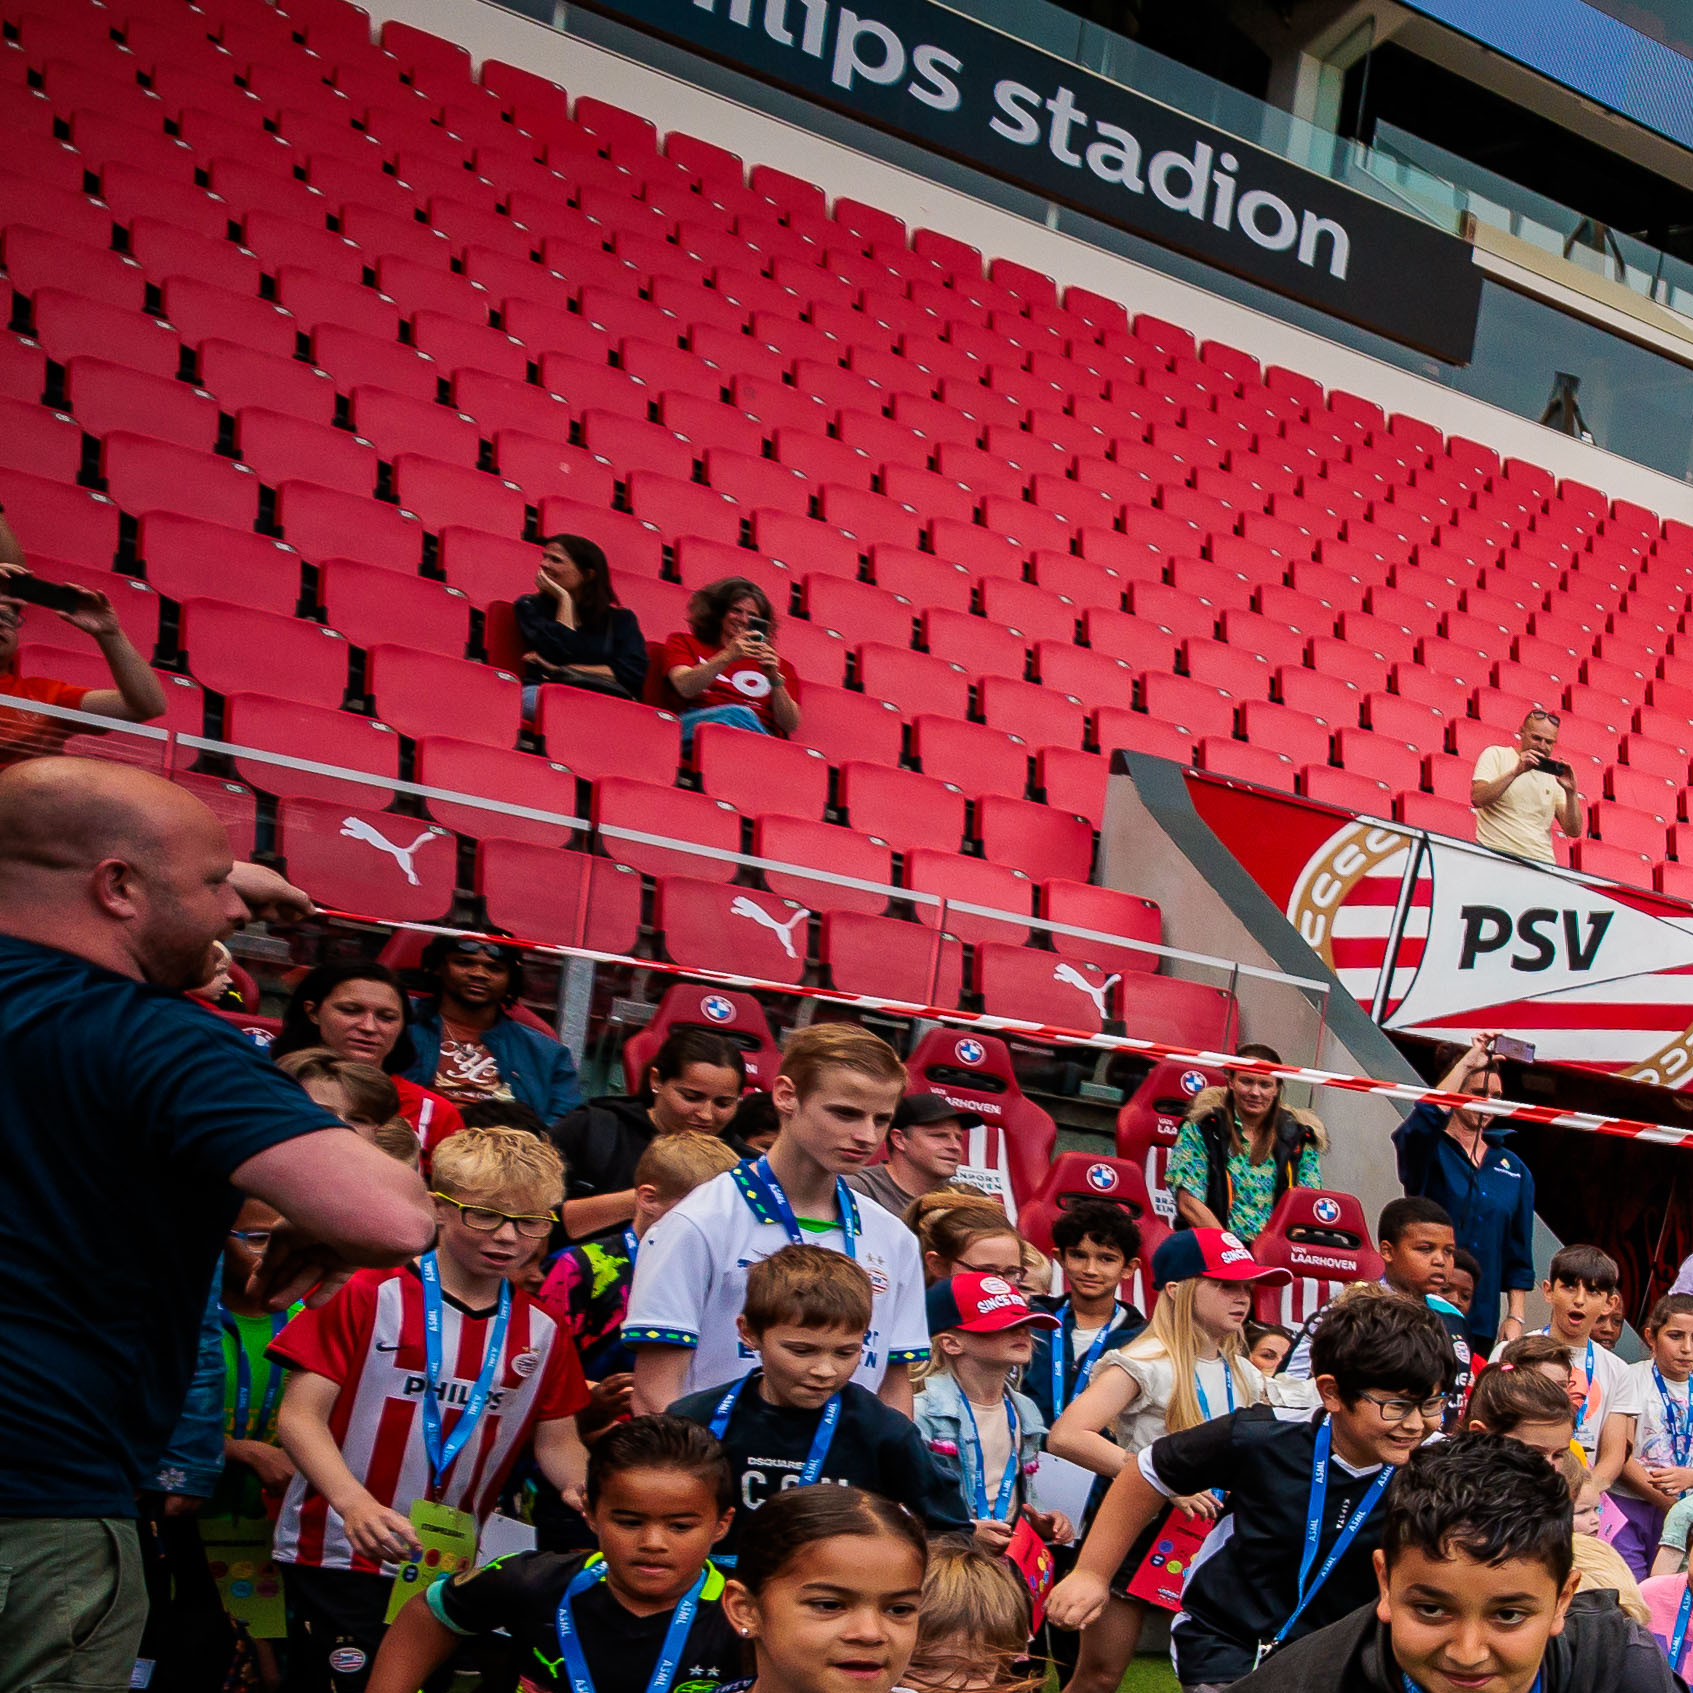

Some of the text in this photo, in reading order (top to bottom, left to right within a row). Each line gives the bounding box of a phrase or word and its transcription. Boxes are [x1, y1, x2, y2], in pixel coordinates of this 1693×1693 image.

[692, 0, 1350, 280] lips stadion
[1458, 904, 1615, 972] PSV
[945, 1096, 1002, 1115] ARHOVEN
[1291, 1246, 1307, 1254] VAN
[1291, 1252, 1357, 1271] LAARHOVEN
[976, 1295, 1007, 1314] SINCE
[747, 1457, 806, 1470] DSQUARE
[804, 1458, 822, 1481] ASML
[1315, 1460, 1325, 1484] ASML
[1378, 1465, 1394, 1487] ASML
[1308, 1518, 1319, 1543] ASML
[1349, 1510, 1366, 1533] ASML
[559, 1608, 572, 1637] ASML
[675, 1600, 693, 1625] ASML
[654, 1659, 673, 1687] ASML
